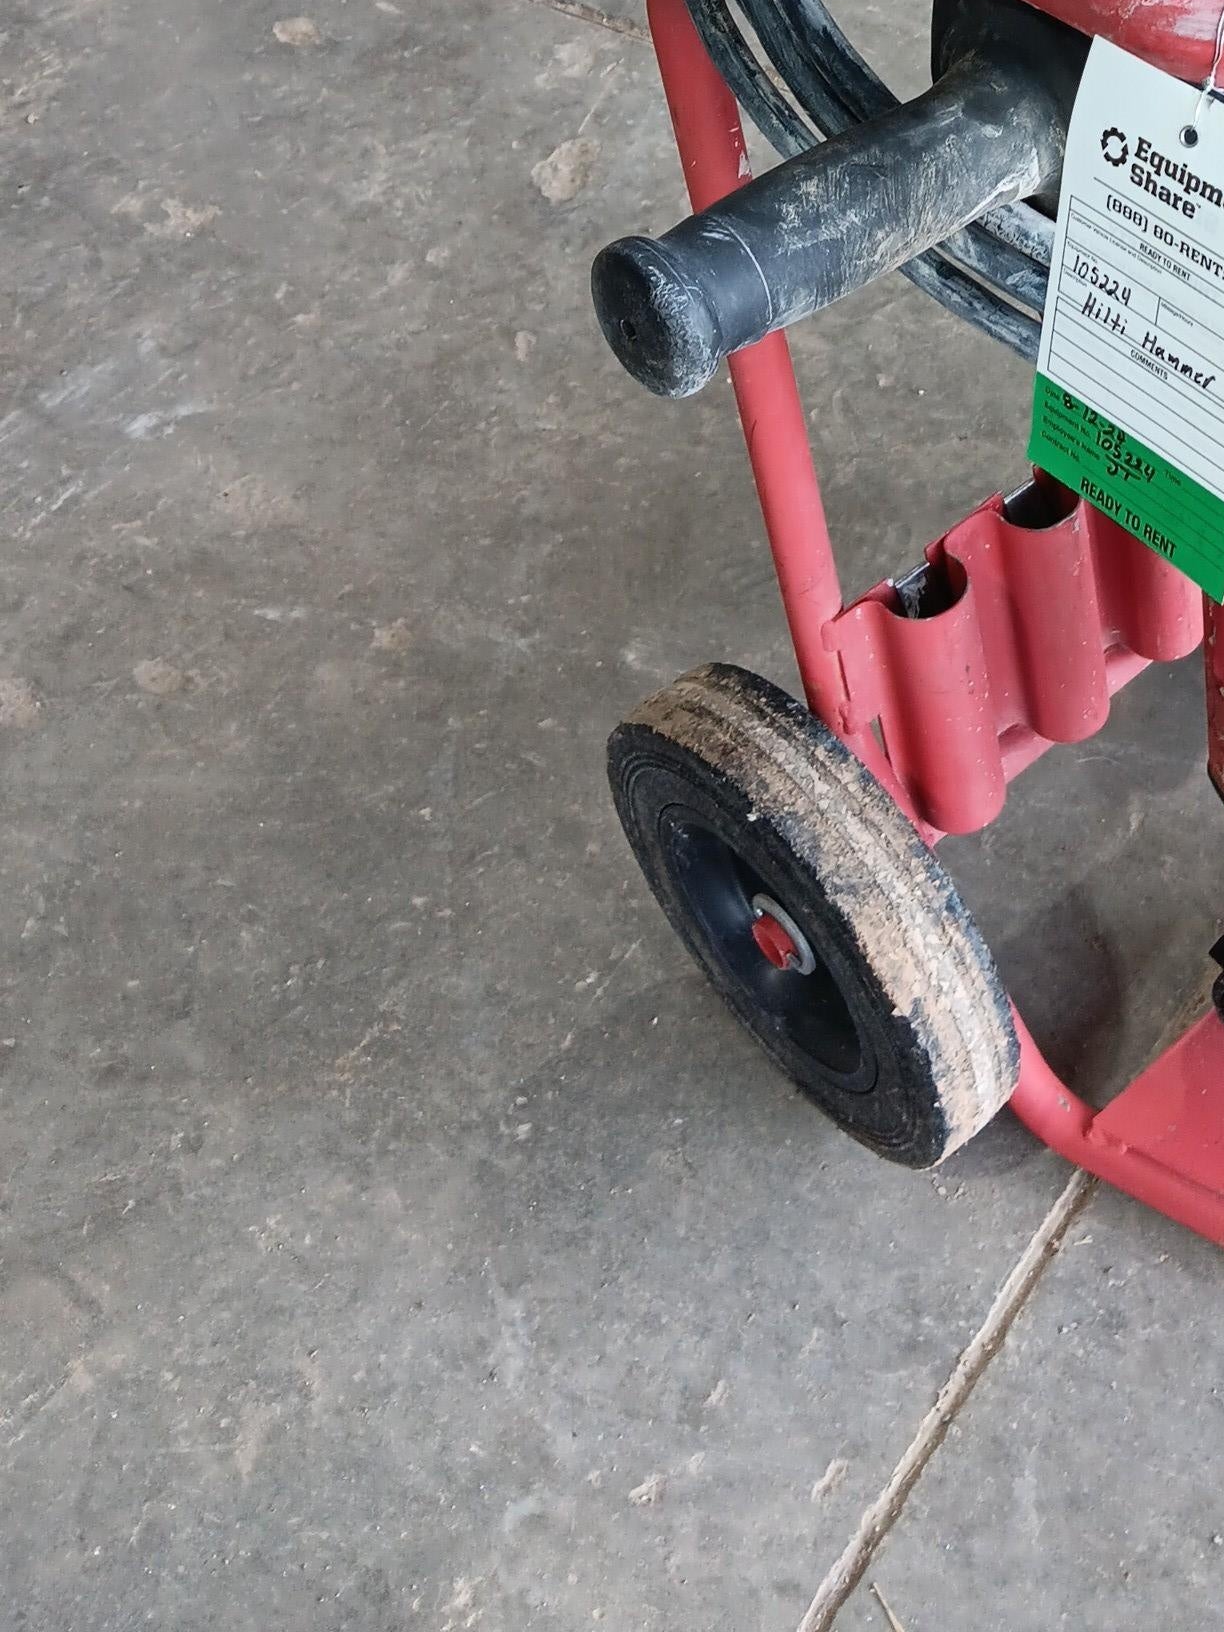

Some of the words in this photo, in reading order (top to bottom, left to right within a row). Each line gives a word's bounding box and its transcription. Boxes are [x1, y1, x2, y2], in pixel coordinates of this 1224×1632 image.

[1105, 193, 1149, 234] (888)
[1072, 254, 1132, 307] 105224
[1138, 242, 1163, 263] READY
[1162, 257, 1173, 270] TO
[1172, 263, 1192, 282] RENT
[1081, 291, 1128, 336] Hilti
[1141, 330, 1217, 390] Hammer
[1130, 349, 1169, 381] COMMENTS
[1079, 475, 1123, 517] READY
[1123, 507, 1141, 531] TO
[1142, 522, 1177, 559] RENT
